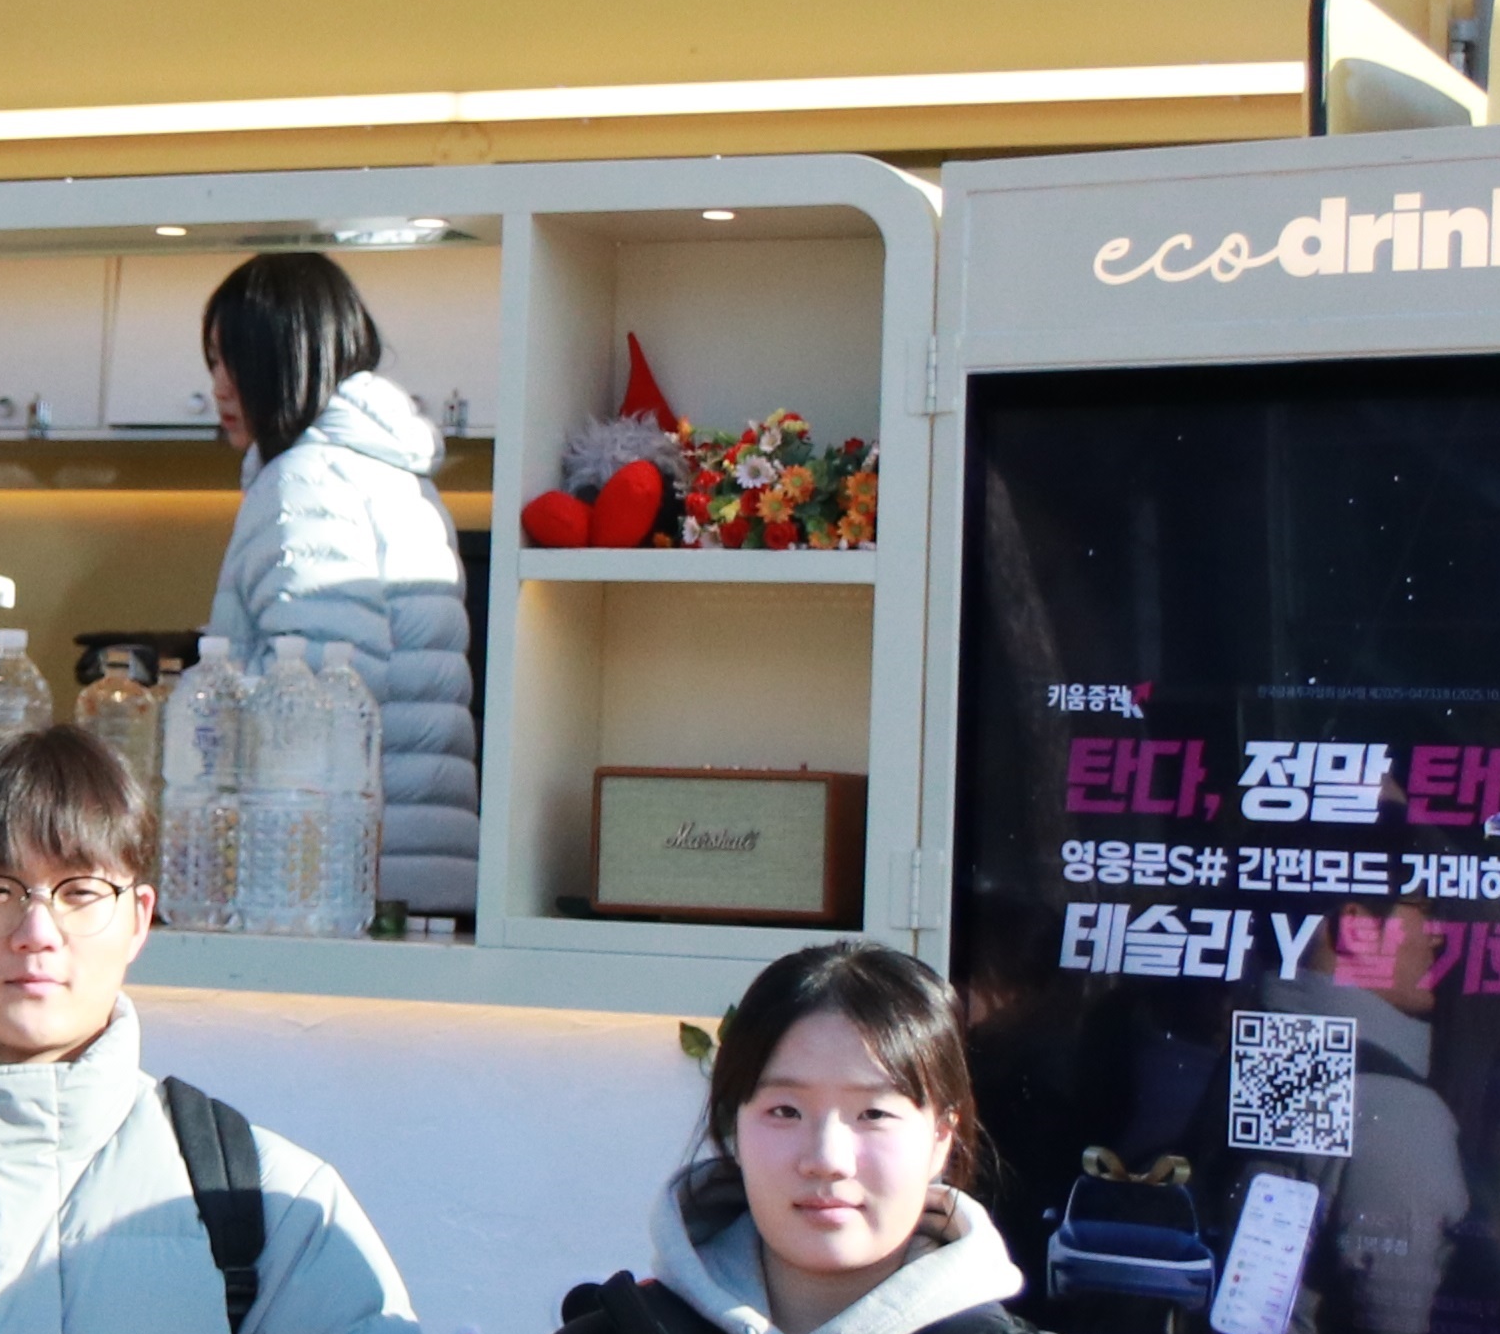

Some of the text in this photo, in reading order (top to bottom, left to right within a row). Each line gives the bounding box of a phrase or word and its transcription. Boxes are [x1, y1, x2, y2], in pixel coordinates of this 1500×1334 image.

[1046, 684, 1128, 714] 키움증권
[1066, 737, 1221, 821] 탄다,
[1238, 740, 1393, 823] 정말
[664, 821, 760, 851] Marshall
[1061, 839, 1228, 886] 영웅문S#
[1238, 846, 1389, 894] 간편모드
[1059, 902, 1255, 982] 테슬라
[1271, 912, 1325, 981] Y
[1333, 914, 1409, 990] 탈
